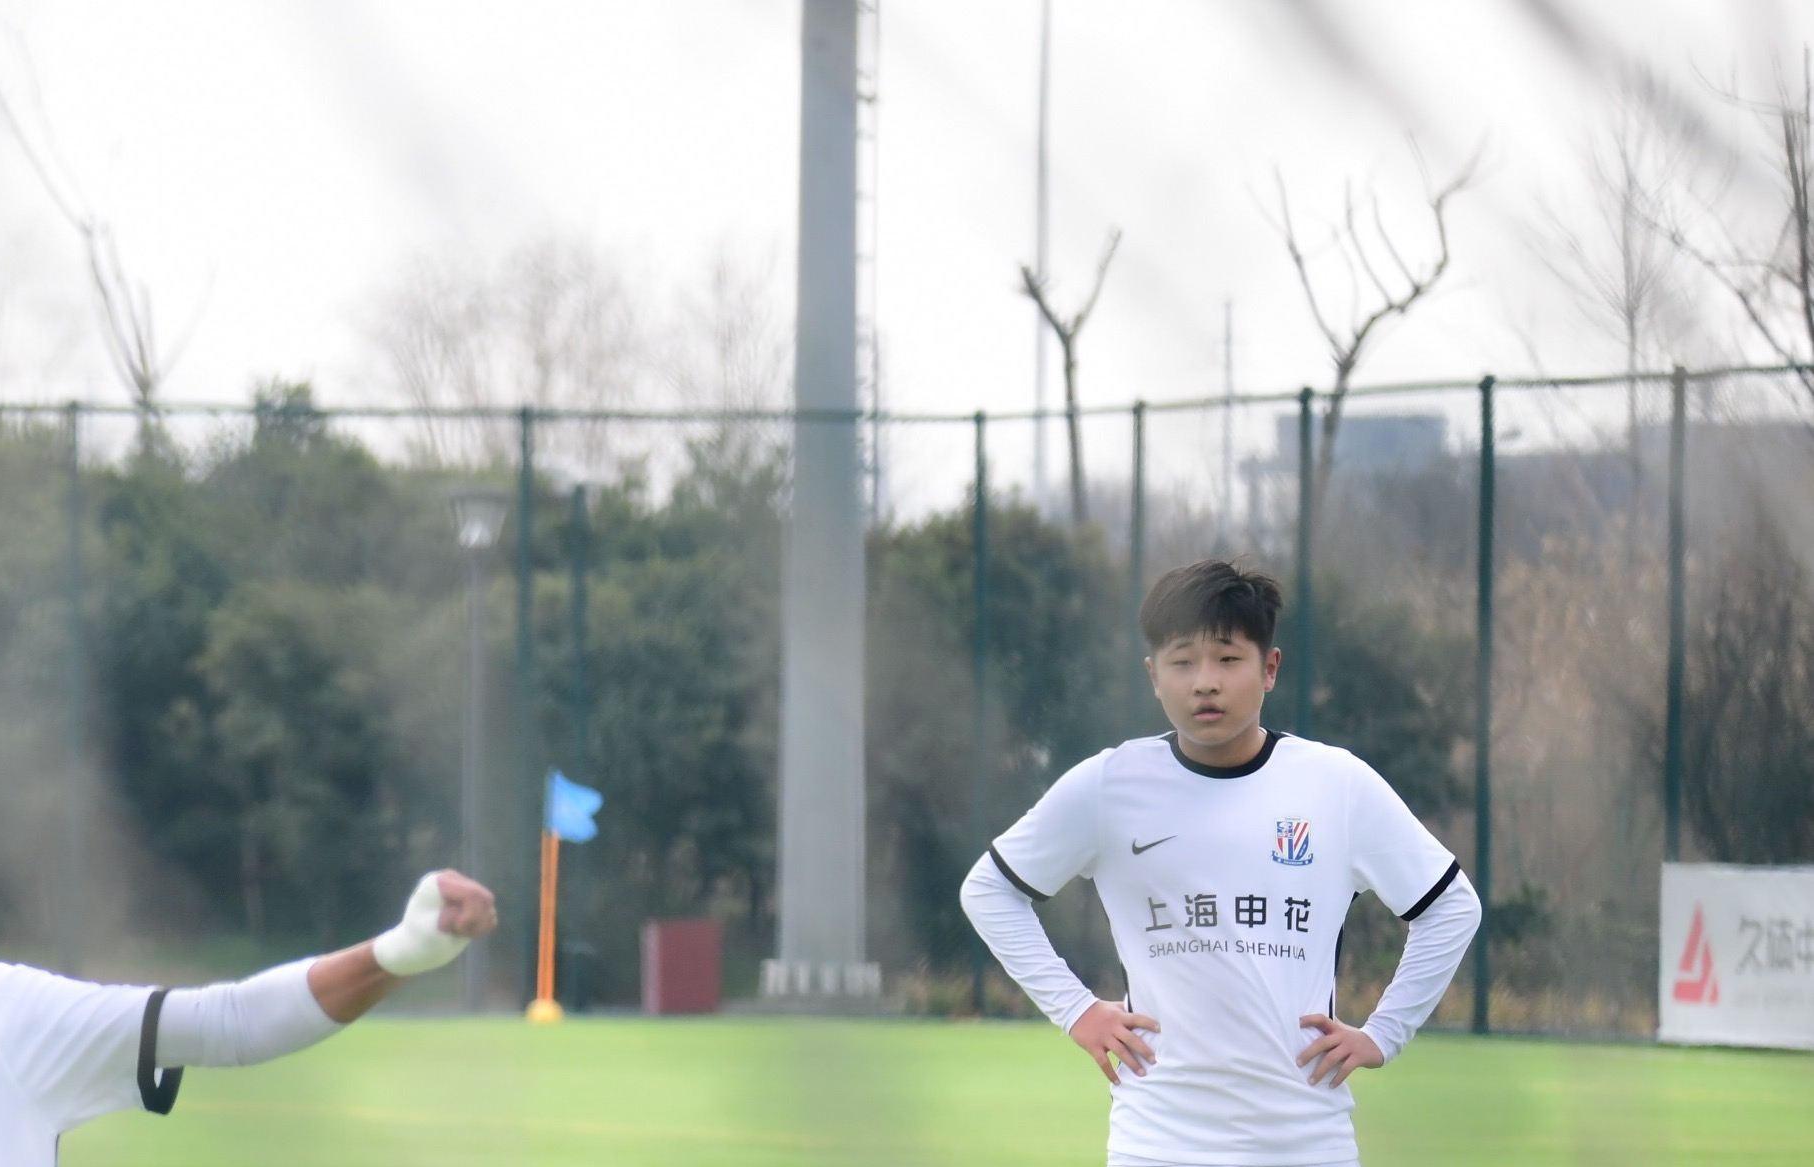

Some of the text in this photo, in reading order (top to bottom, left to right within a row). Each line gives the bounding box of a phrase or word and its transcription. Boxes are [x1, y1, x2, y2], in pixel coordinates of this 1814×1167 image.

[1145, 893, 1311, 933] 上海申花
[1149, 939, 1306, 961] SHANGHAI SHENHUA
